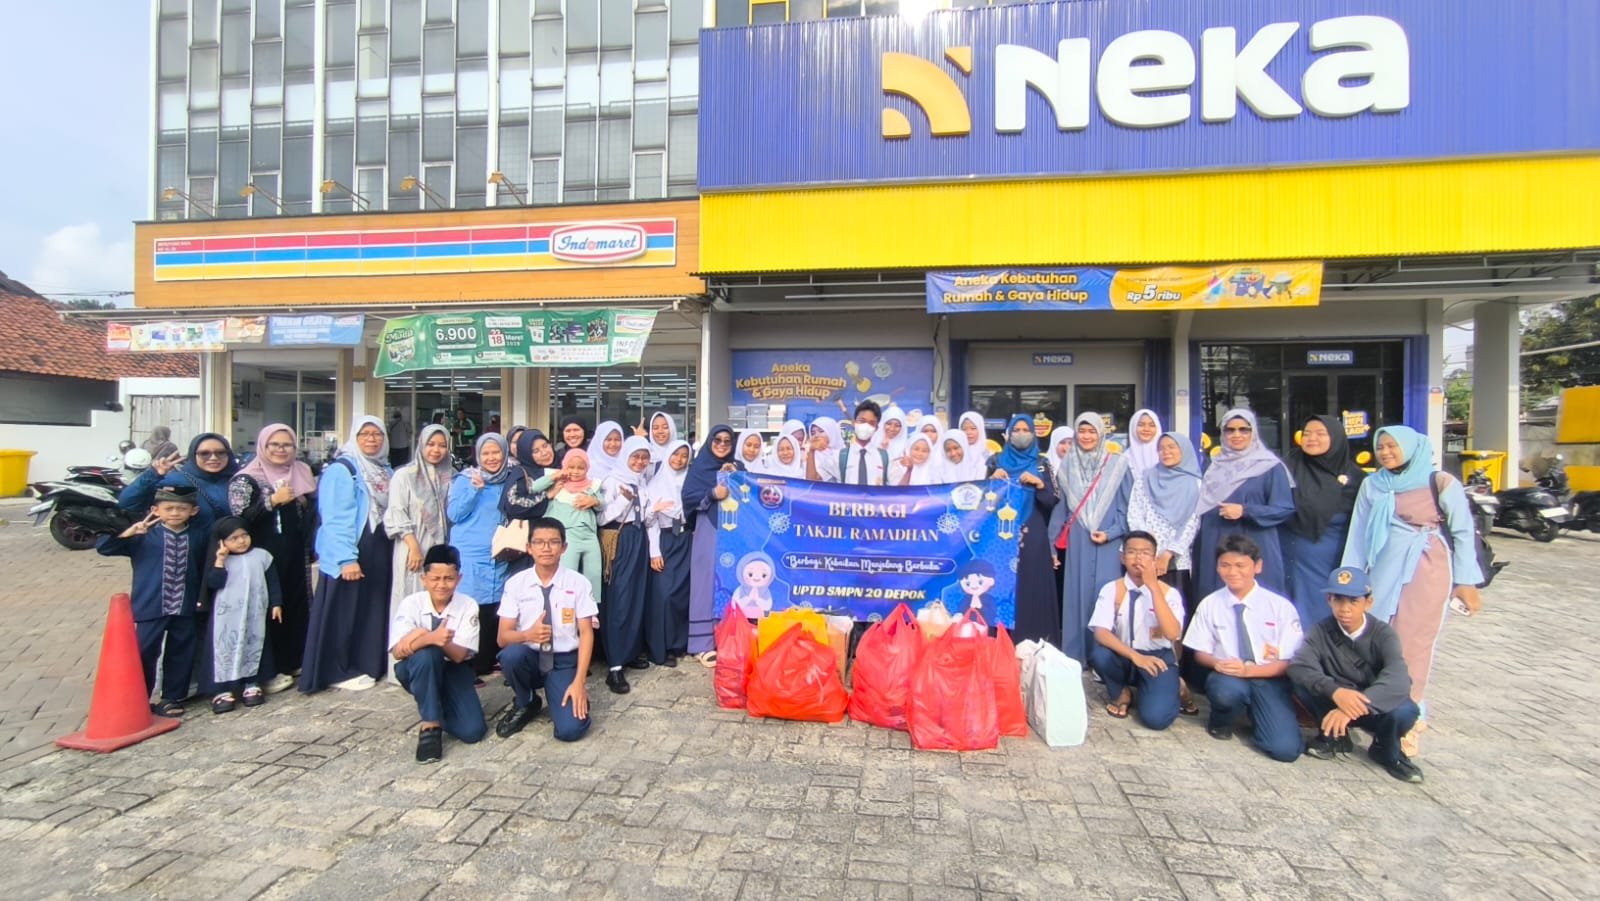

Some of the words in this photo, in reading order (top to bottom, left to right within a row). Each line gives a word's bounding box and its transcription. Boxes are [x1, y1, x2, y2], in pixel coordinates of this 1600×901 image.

[558, 235, 637, 251] Indomaret
[954, 276, 998, 287] Aneka
[1001, 273, 1077, 285] Kebutuhan
[944, 291, 992, 303] Rumah
[995, 290, 1004, 301] &
[1008, 290, 1040, 304] Gaya
[1047, 289, 1088, 303] Hidup
[1157, 290, 1181, 300] ribu
[435, 327, 477, 341] 6.900
[492, 335, 503, 345] 18
[771, 362, 811, 373] Aneka
[736, 374, 802, 389] Kebutuhan
[803, 375, 846, 388] Rumah
[752, 388, 761, 398] &
[762, 388, 793, 399] Gaya
[795, 385, 831, 399] Hidup
[828, 501, 907, 518] BERBAGI
[793, 524, 847, 540] TAKJIL
[850, 527, 939, 542] RAMADHAN
[793, 585, 825, 597] UPTD
[826, 586, 864, 598] SMPN
[866, 587, 882, 599] 20
[884, 588, 926, 600] DEPOK
